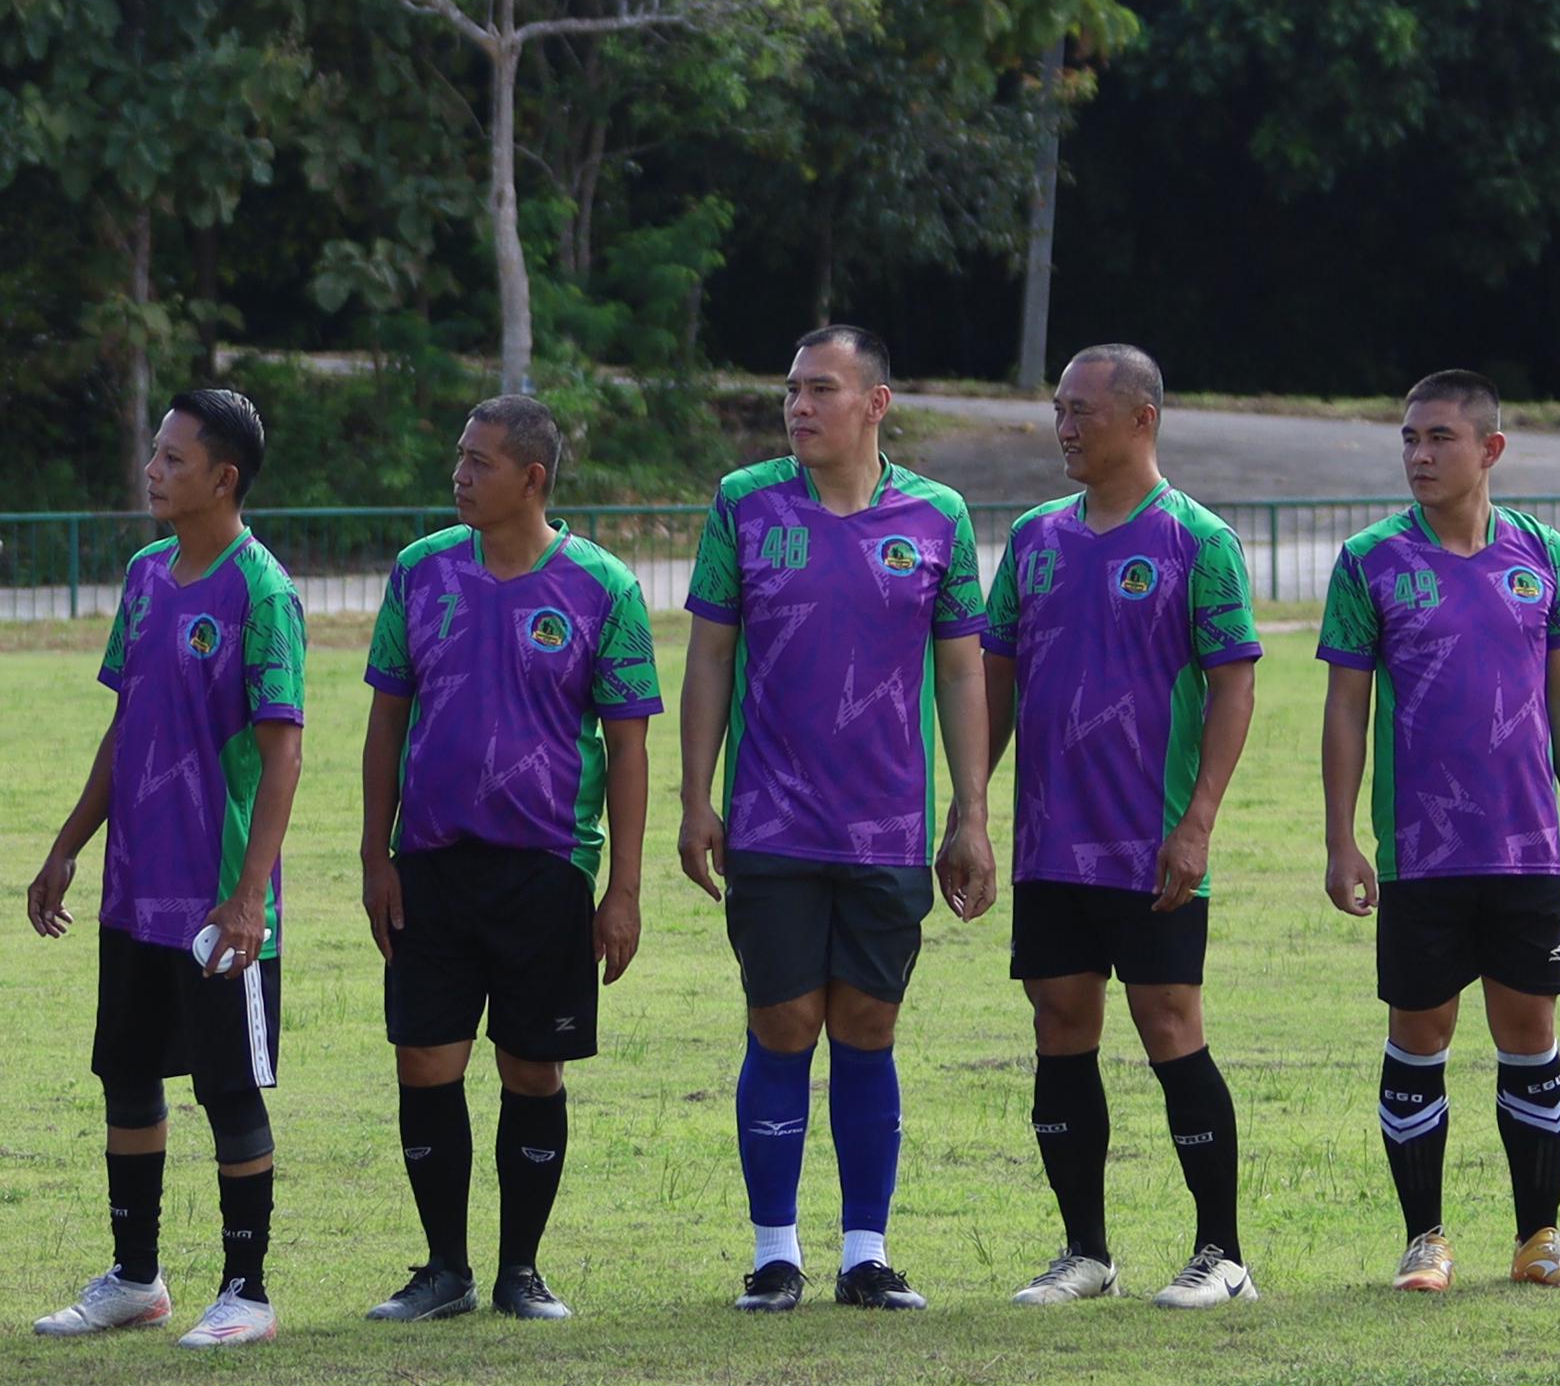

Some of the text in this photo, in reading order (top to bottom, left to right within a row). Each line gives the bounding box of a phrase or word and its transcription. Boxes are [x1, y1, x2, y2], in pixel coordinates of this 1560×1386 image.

[761, 526, 809, 569] 48
[1027, 549, 1057, 594] 13
[1394, 569, 1440, 610] 49
[437, 594, 460, 639] 7
